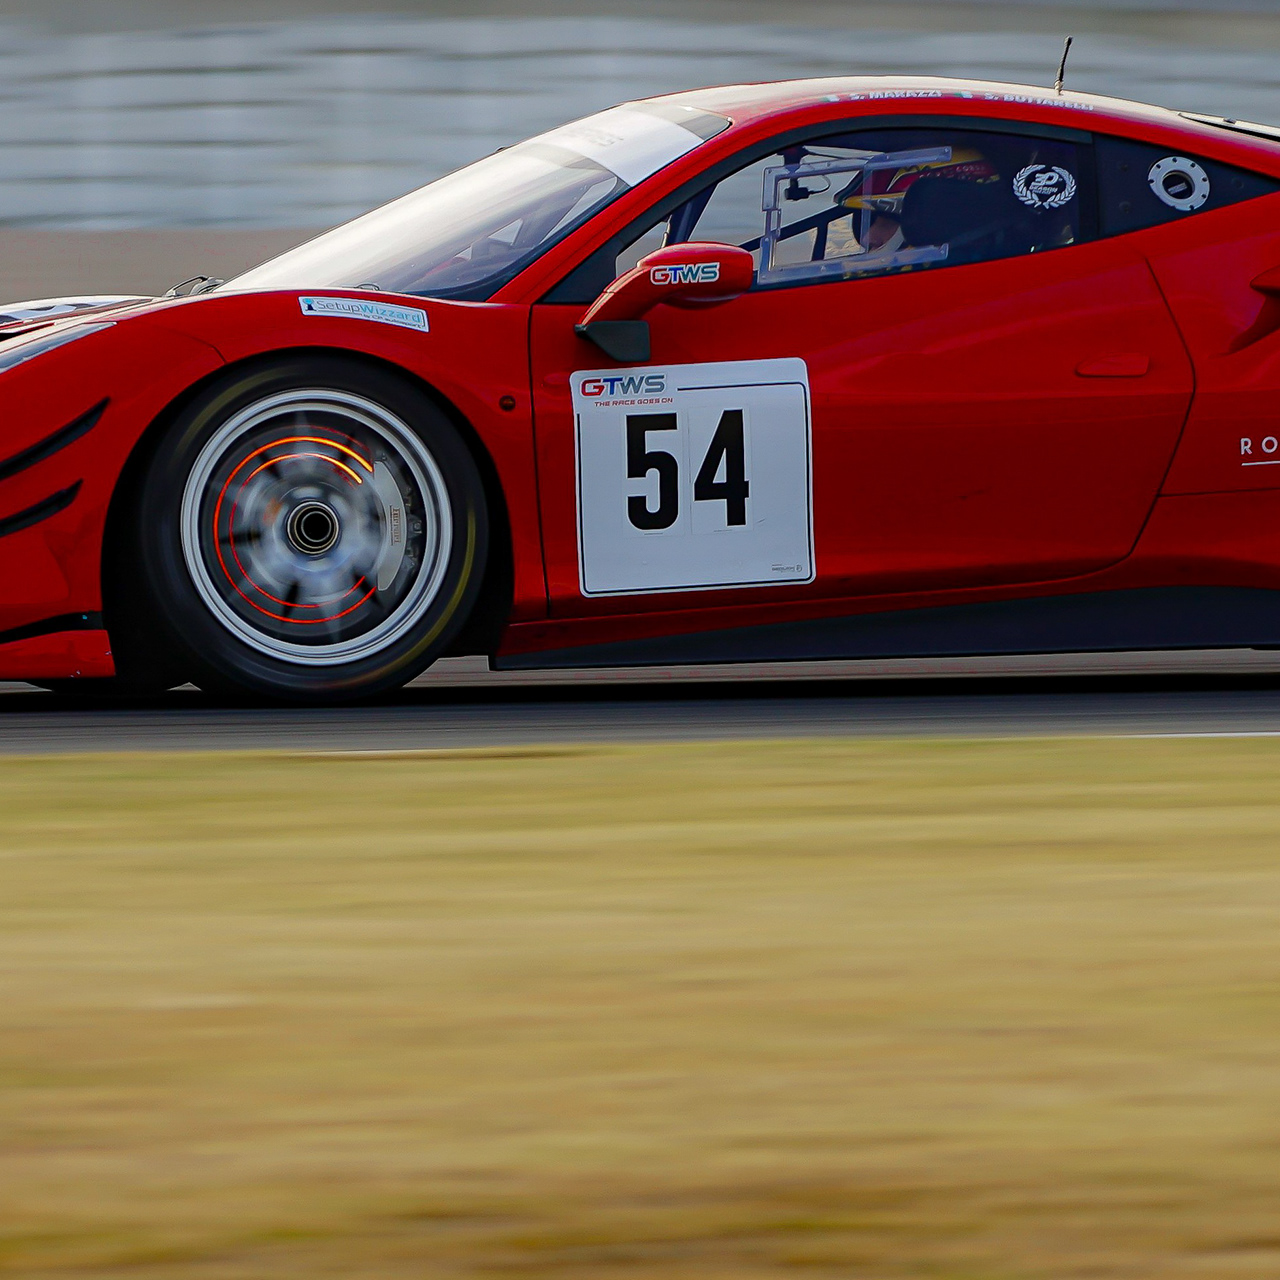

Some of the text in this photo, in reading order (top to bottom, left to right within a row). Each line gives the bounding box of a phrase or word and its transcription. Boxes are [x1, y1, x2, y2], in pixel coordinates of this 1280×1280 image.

[652, 263, 719, 284] GTWS
[317, 300, 422, 324] SetupWizzard
[581, 374, 665, 396] GTWS
[612, 399, 635, 407] RACE
[637, 397, 660, 405] GOES
[625, 408, 750, 531] 54
